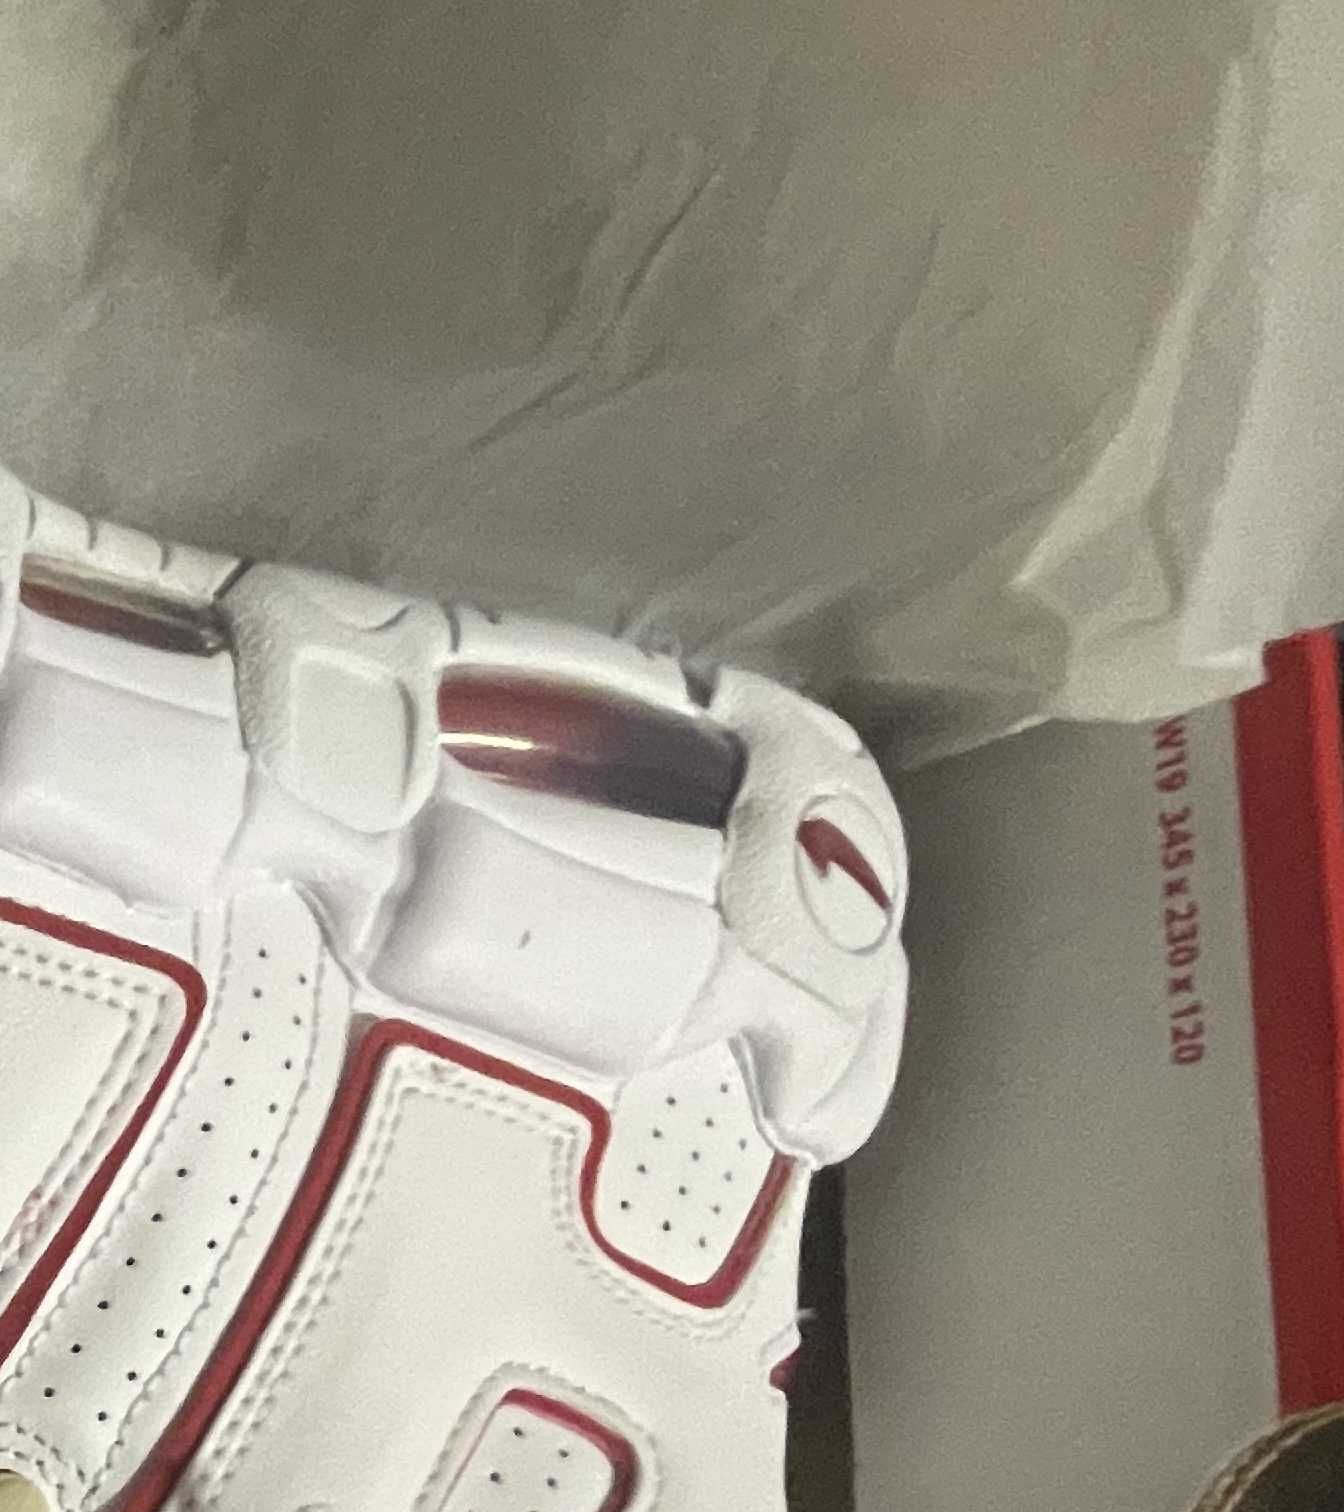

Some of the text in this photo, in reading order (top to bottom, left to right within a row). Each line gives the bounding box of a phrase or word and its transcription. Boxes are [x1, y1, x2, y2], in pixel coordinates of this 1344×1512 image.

[1153, 714, 1205, 1066] W19 345 x 230 x 120
